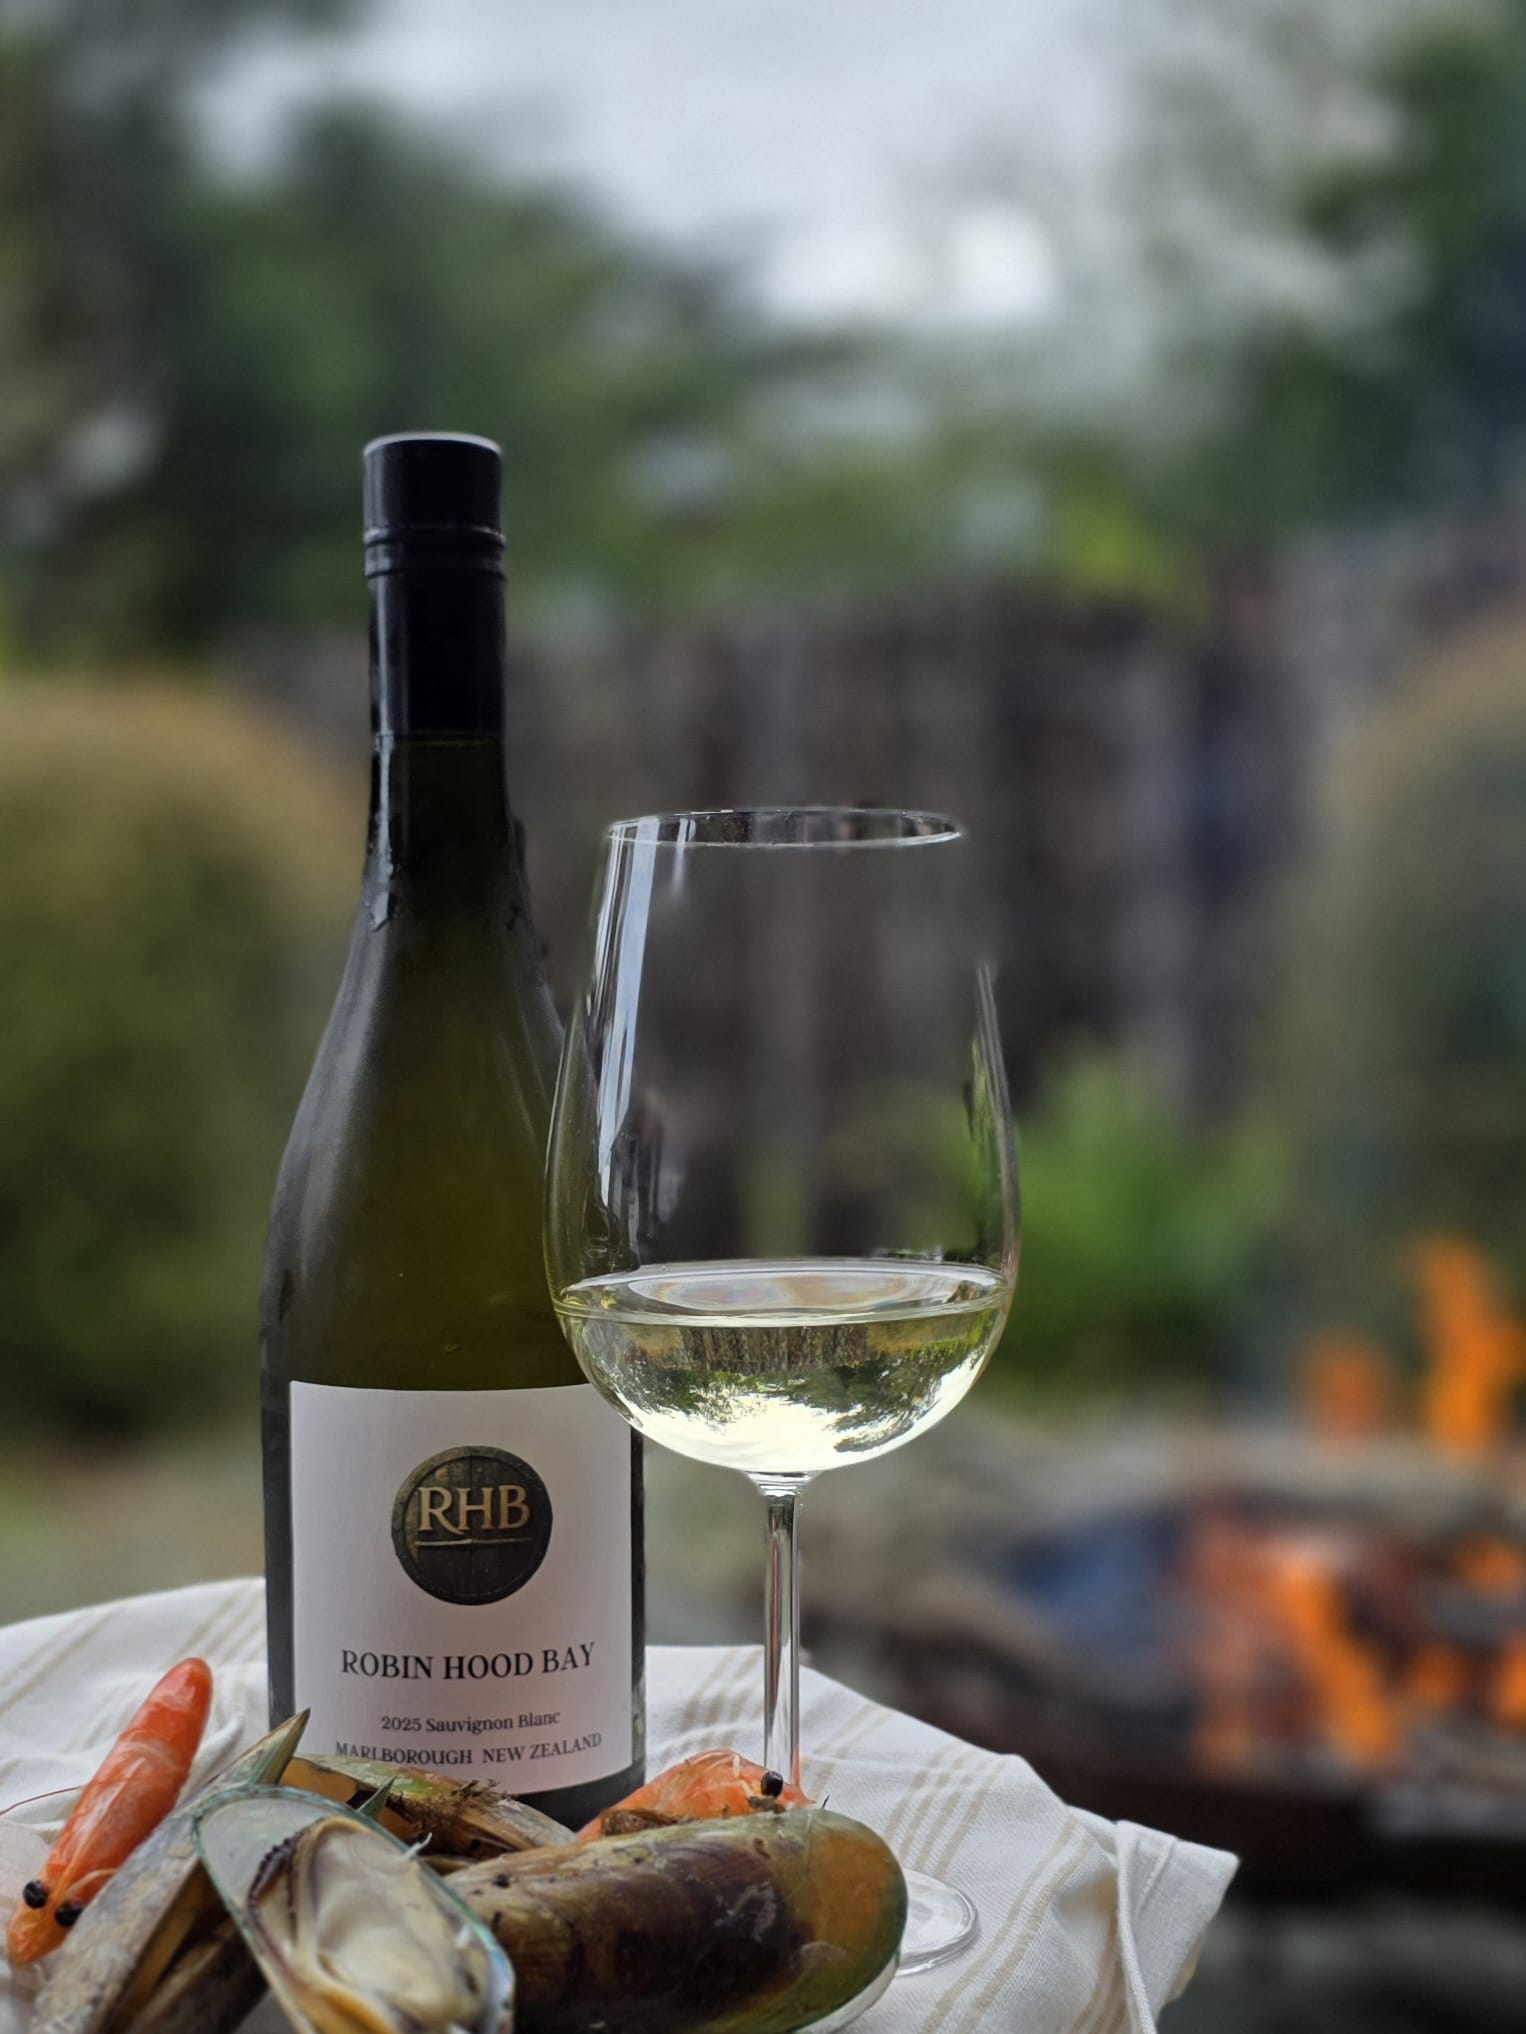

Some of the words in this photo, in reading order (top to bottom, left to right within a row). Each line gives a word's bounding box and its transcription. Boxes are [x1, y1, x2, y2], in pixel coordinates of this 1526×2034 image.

[418, 1484, 530, 1535] RHB
[342, 1649, 434, 1680] ROBIN
[442, 1653, 533, 1680] HOOD
[542, 1641, 596, 1674] BAY
[381, 1716, 422, 1732] 2025
[426, 1715, 513, 1735] Sauvignon
[518, 1711, 561, 1726] Blanc
[335, 1742, 473, 1765] MARLBOROUGH
[482, 1746, 527, 1764] NEW
[529, 1732, 602, 1760] ZEALAND
